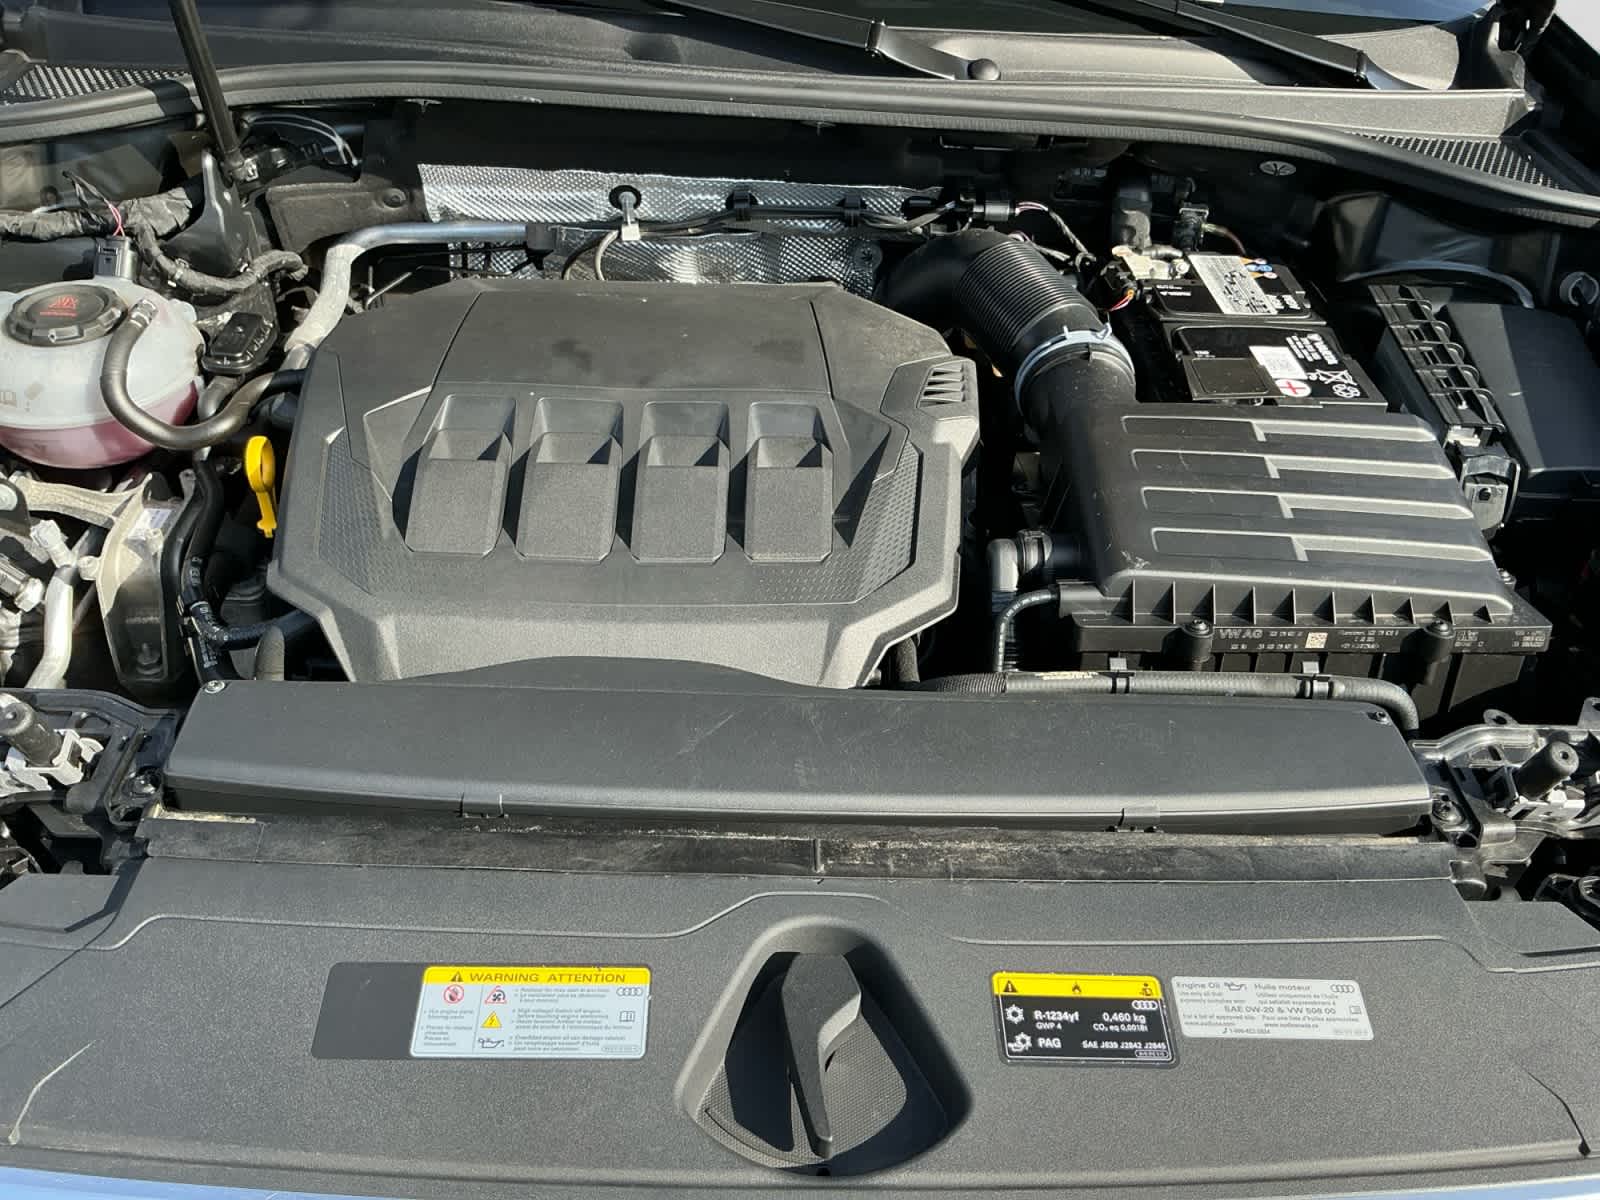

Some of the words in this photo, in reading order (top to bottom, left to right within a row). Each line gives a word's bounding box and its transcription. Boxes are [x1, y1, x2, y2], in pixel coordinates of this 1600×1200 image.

[1219, 629, 1241, 639] VW
[1242, 629, 1263, 639] AG
[469, 973, 539, 983] WARNING
[548, 973, 626, 983] ATTENTION
[1033, 1010, 1079, 1023] R-1234yf
[1102, 1012, 1131, 1022] 0,460
[1133, 1013, 1146, 1024] kg
[1038, 1038, 1062, 1048] PAG
[1082, 1040, 1098, 1048] SAE
